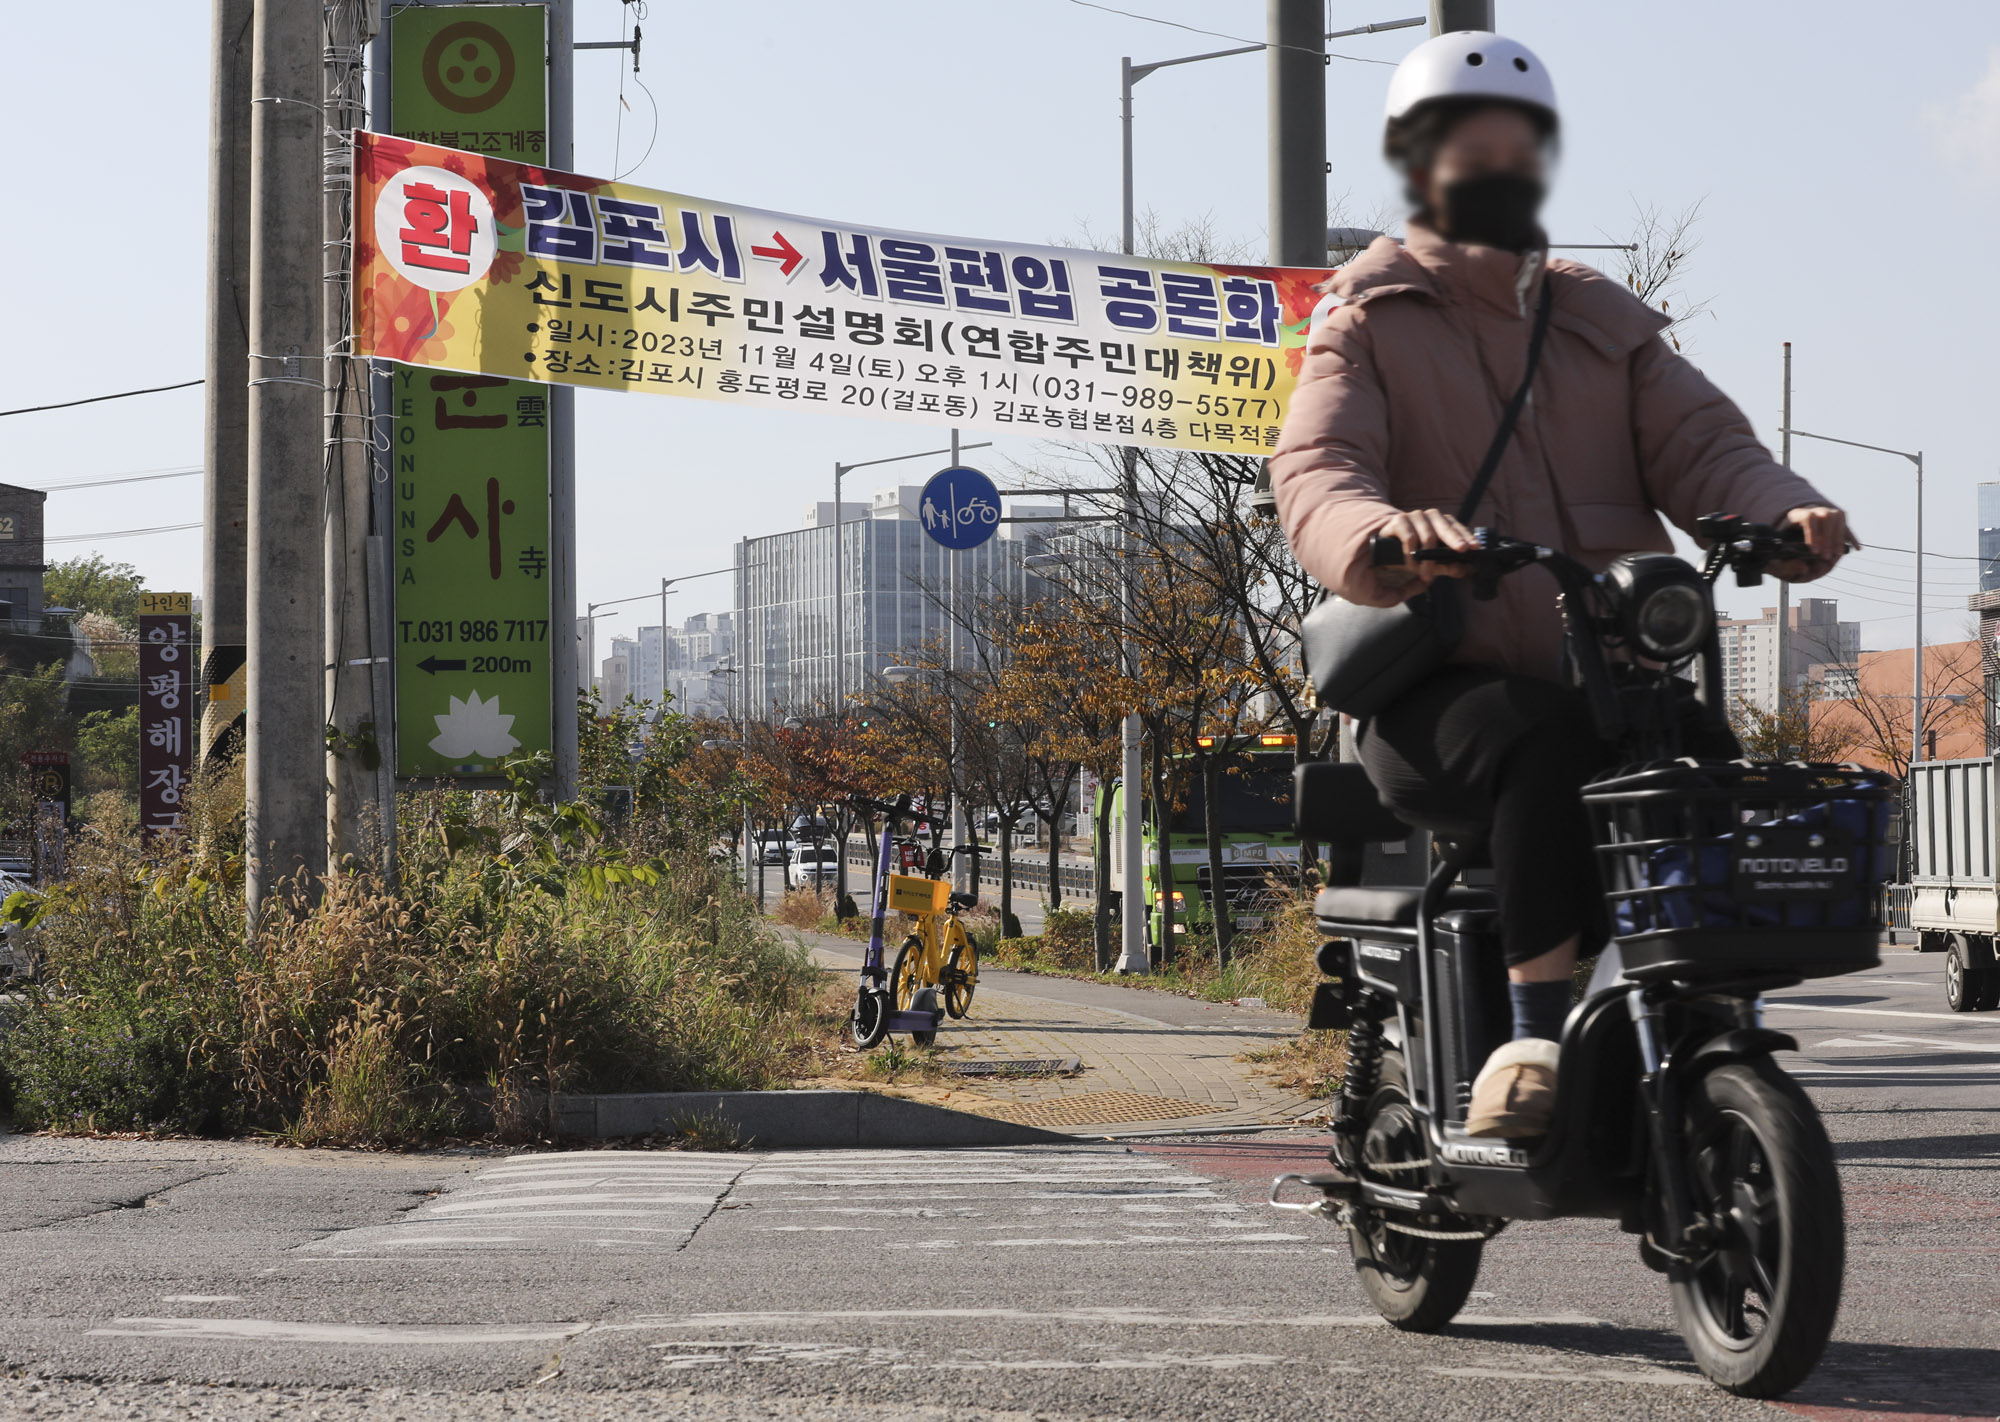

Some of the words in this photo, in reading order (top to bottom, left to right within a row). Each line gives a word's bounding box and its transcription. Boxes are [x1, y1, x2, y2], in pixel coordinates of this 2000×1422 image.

[400, 182, 478, 274] 환
[521, 184, 744, 282] 김포시
[818, 230, 1076, 323] 서울편입
[1097, 265, 1282, 346] 공론화
[738, 344, 797, 369] 11월
[914, 363, 967, 388] 오후
[980, 371, 1018, 395] 1시
[1032, 374, 1281, 420] (031-989-5577)
[717, 369, 828, 402] 홍도평로
[1189, 422, 1281, 447] 다목적홀
[401, 371, 416, 584] YEONUNSA
[143, 595, 189, 612] 나인식
[400, 620, 453, 643] T.031
[460, 620, 498, 642] 986
[504, 620, 548, 642] 7117
[472, 656, 531, 673] 200m
[1233, 849, 1264, 858] GIMPO
[1739, 858, 1848, 873] MOTOVELO
